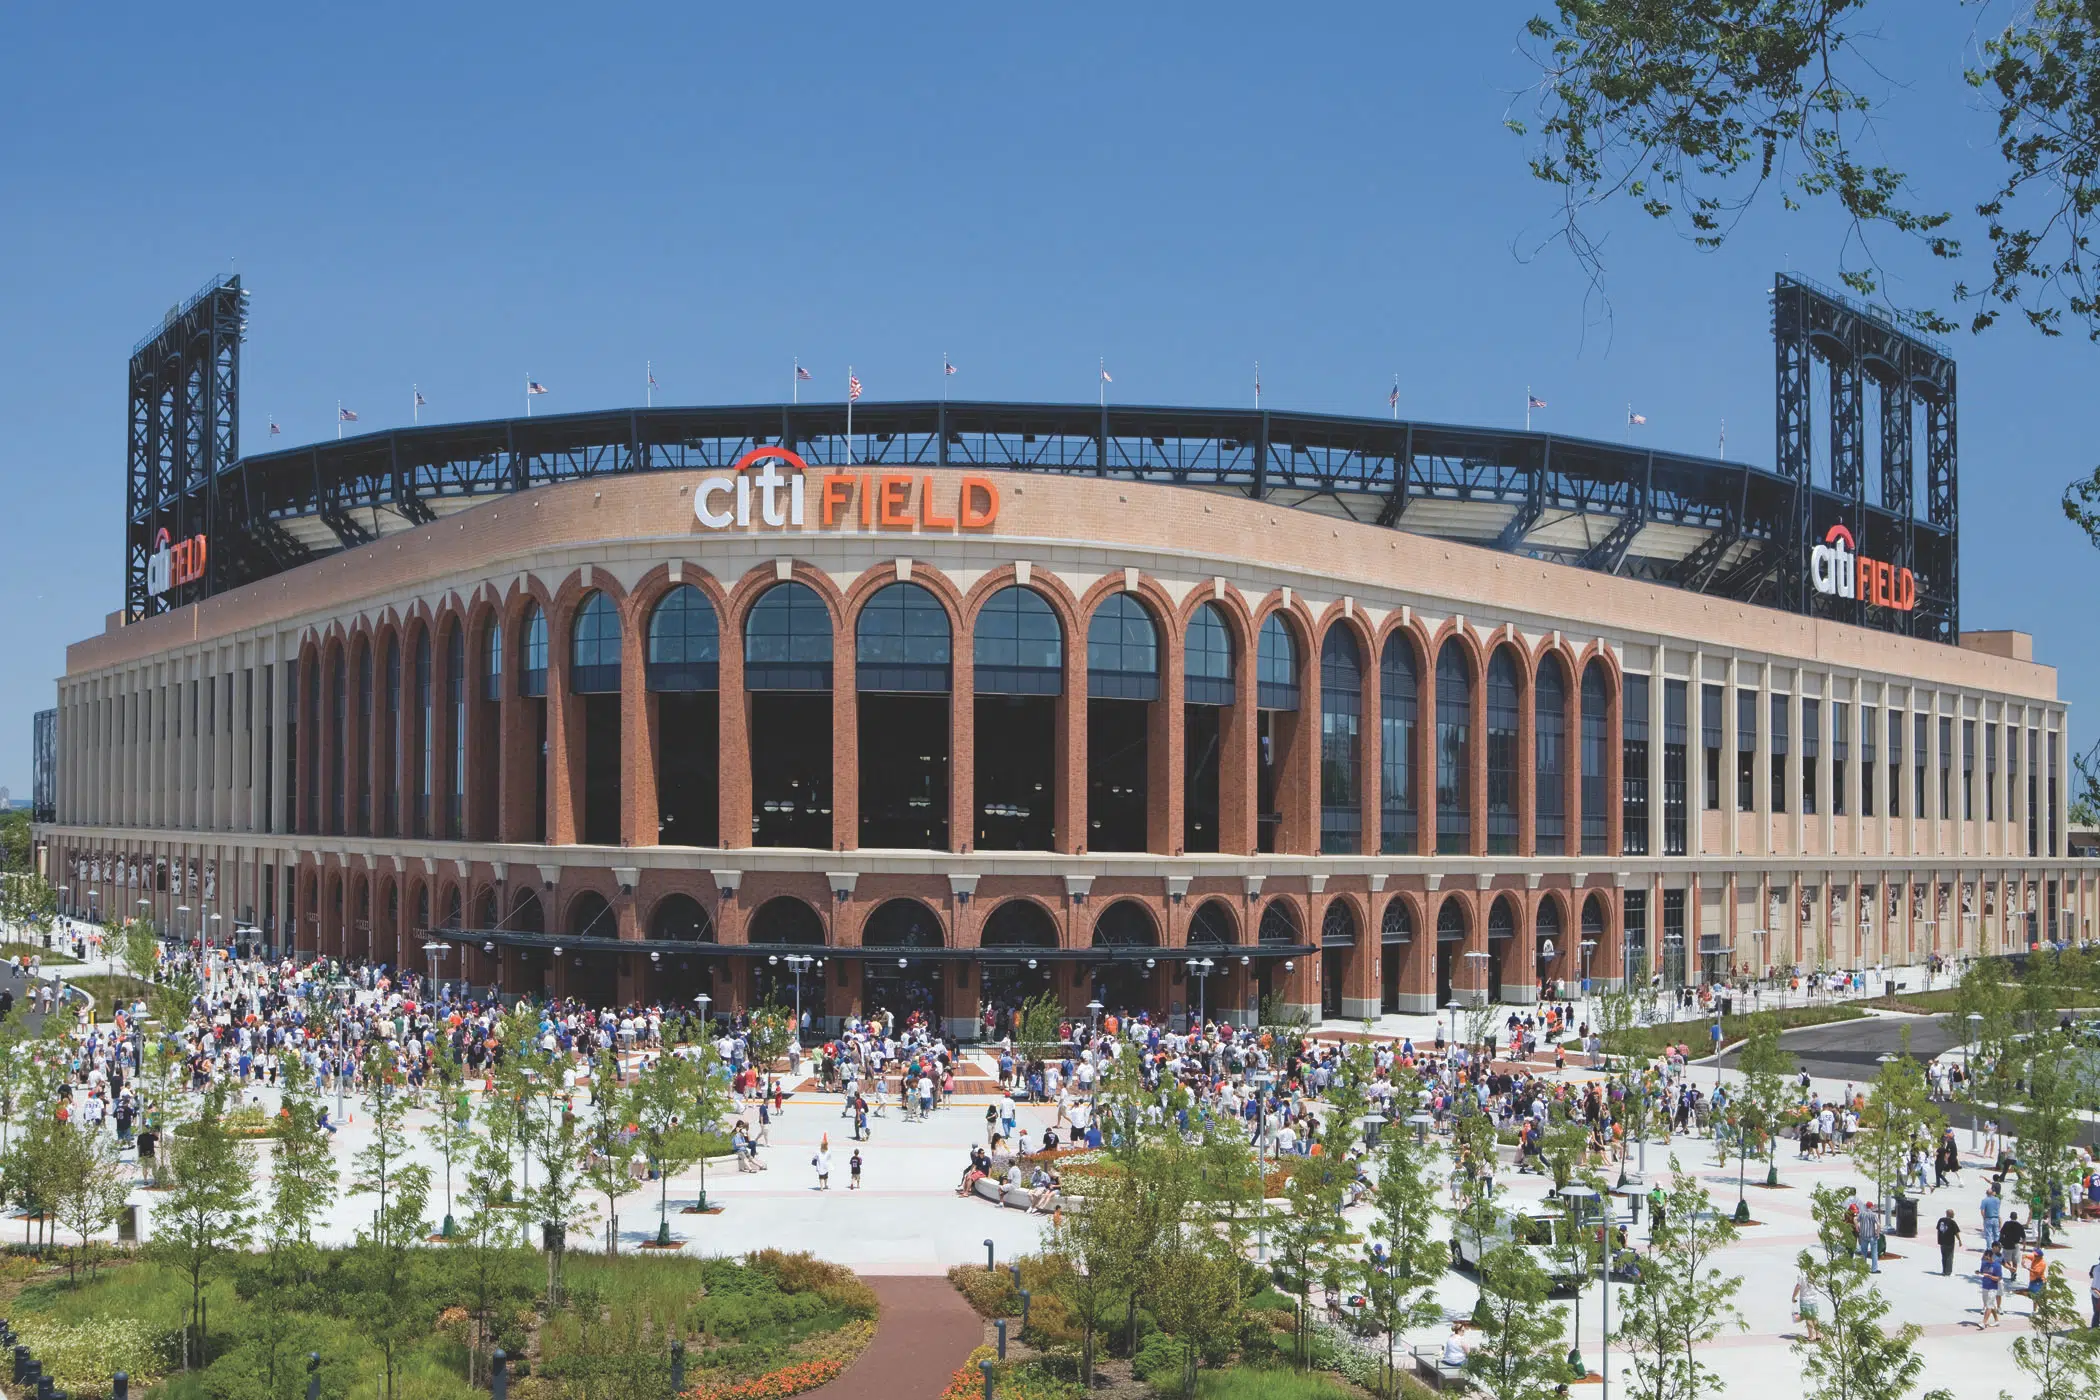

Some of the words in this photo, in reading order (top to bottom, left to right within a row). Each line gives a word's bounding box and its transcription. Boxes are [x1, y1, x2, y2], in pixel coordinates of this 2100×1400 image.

[694, 460, 804, 528] citi
[823, 474, 1000, 528] FIELD
[1811, 536, 1855, 599] citi
[1857, 555, 1915, 611] FIELD
